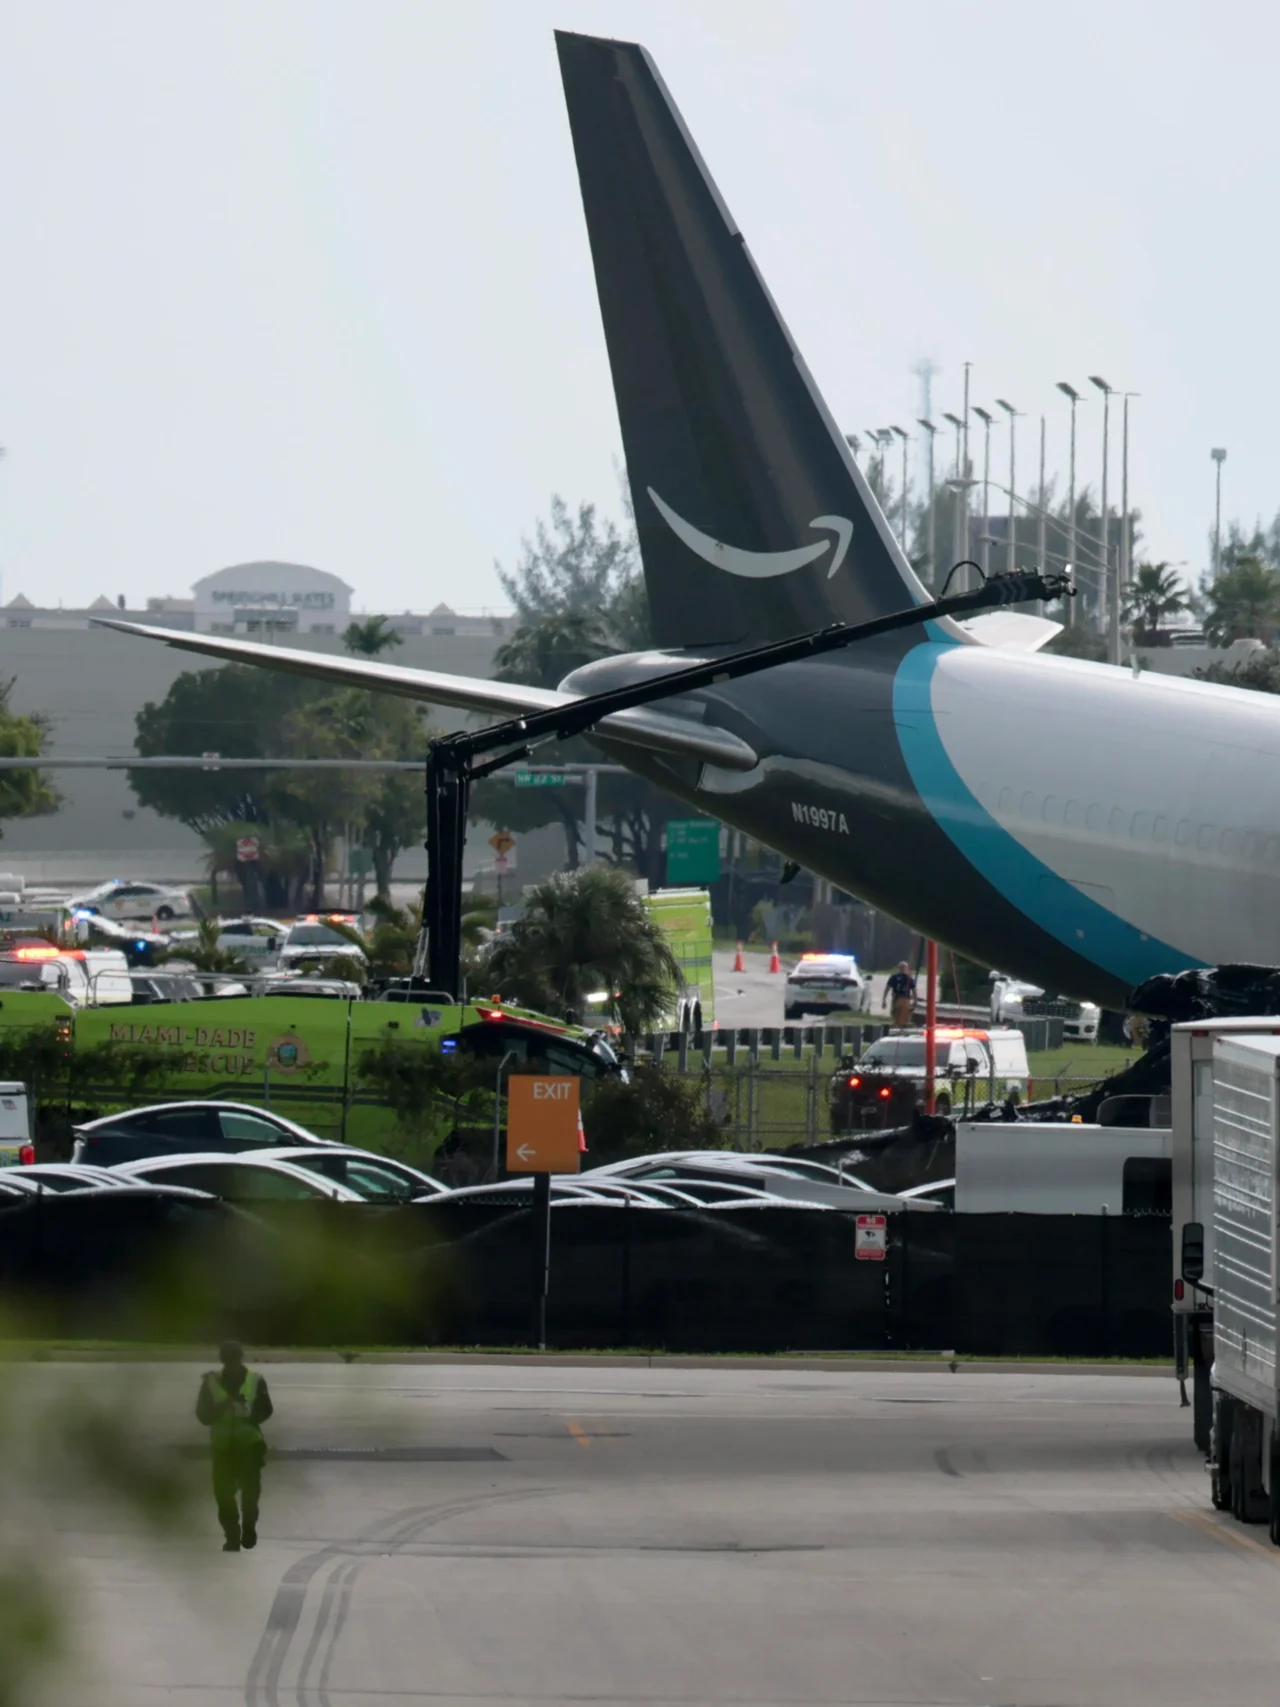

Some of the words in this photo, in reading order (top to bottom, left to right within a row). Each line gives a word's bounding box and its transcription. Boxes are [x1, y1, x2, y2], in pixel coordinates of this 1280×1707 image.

[791, 801, 850, 835] N1997A
[110, 1023, 256, 1049] MIAMI-DADE
[180, 1051, 255, 1076] ESCUE
[533, 1082, 572, 1100] EXIT
